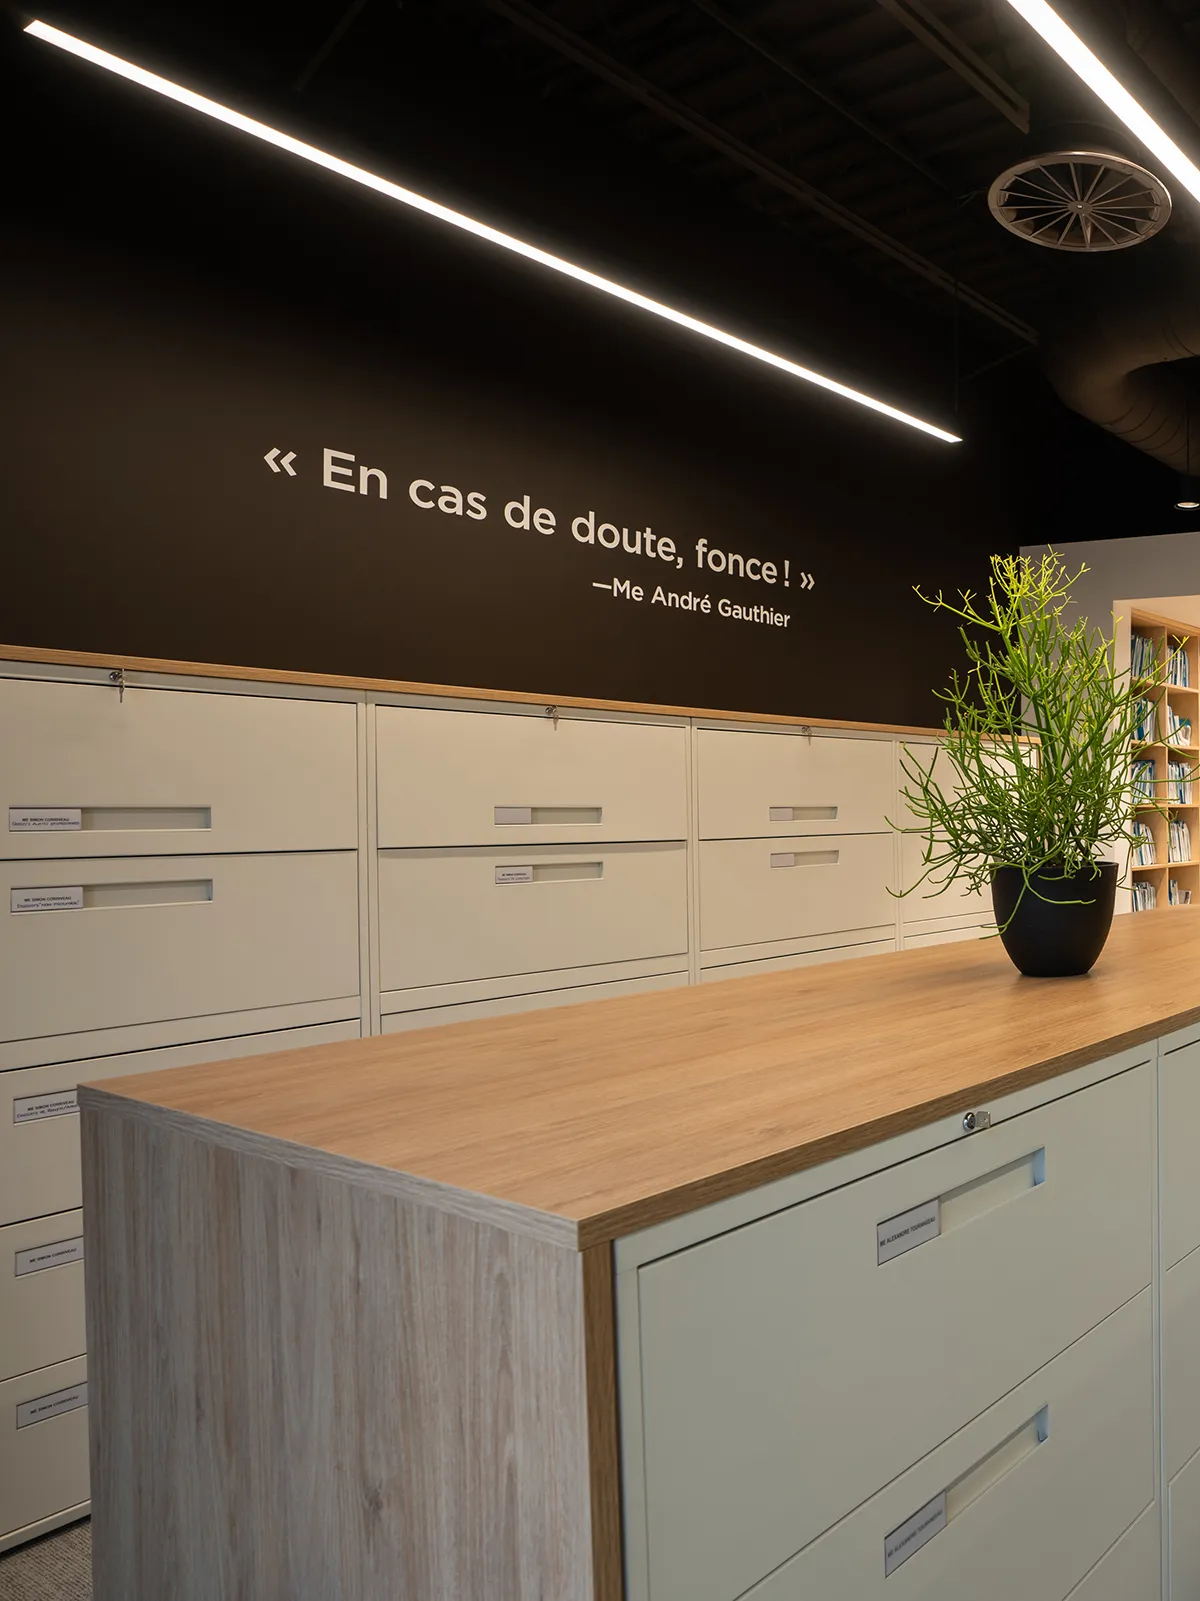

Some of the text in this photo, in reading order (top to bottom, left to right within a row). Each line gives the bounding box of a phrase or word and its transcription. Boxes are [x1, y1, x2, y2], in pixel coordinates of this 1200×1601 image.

[322, 447, 388, 500] En
[408, 479, 488, 521] cas
[503, 494, 557, 536] de
[571, 510, 684, 569] doute,
[650, 585, 712, 614] André
[717, 598, 791, 628] Gauthier
[886, 1227, 910, 1244] ALEXANDRE
